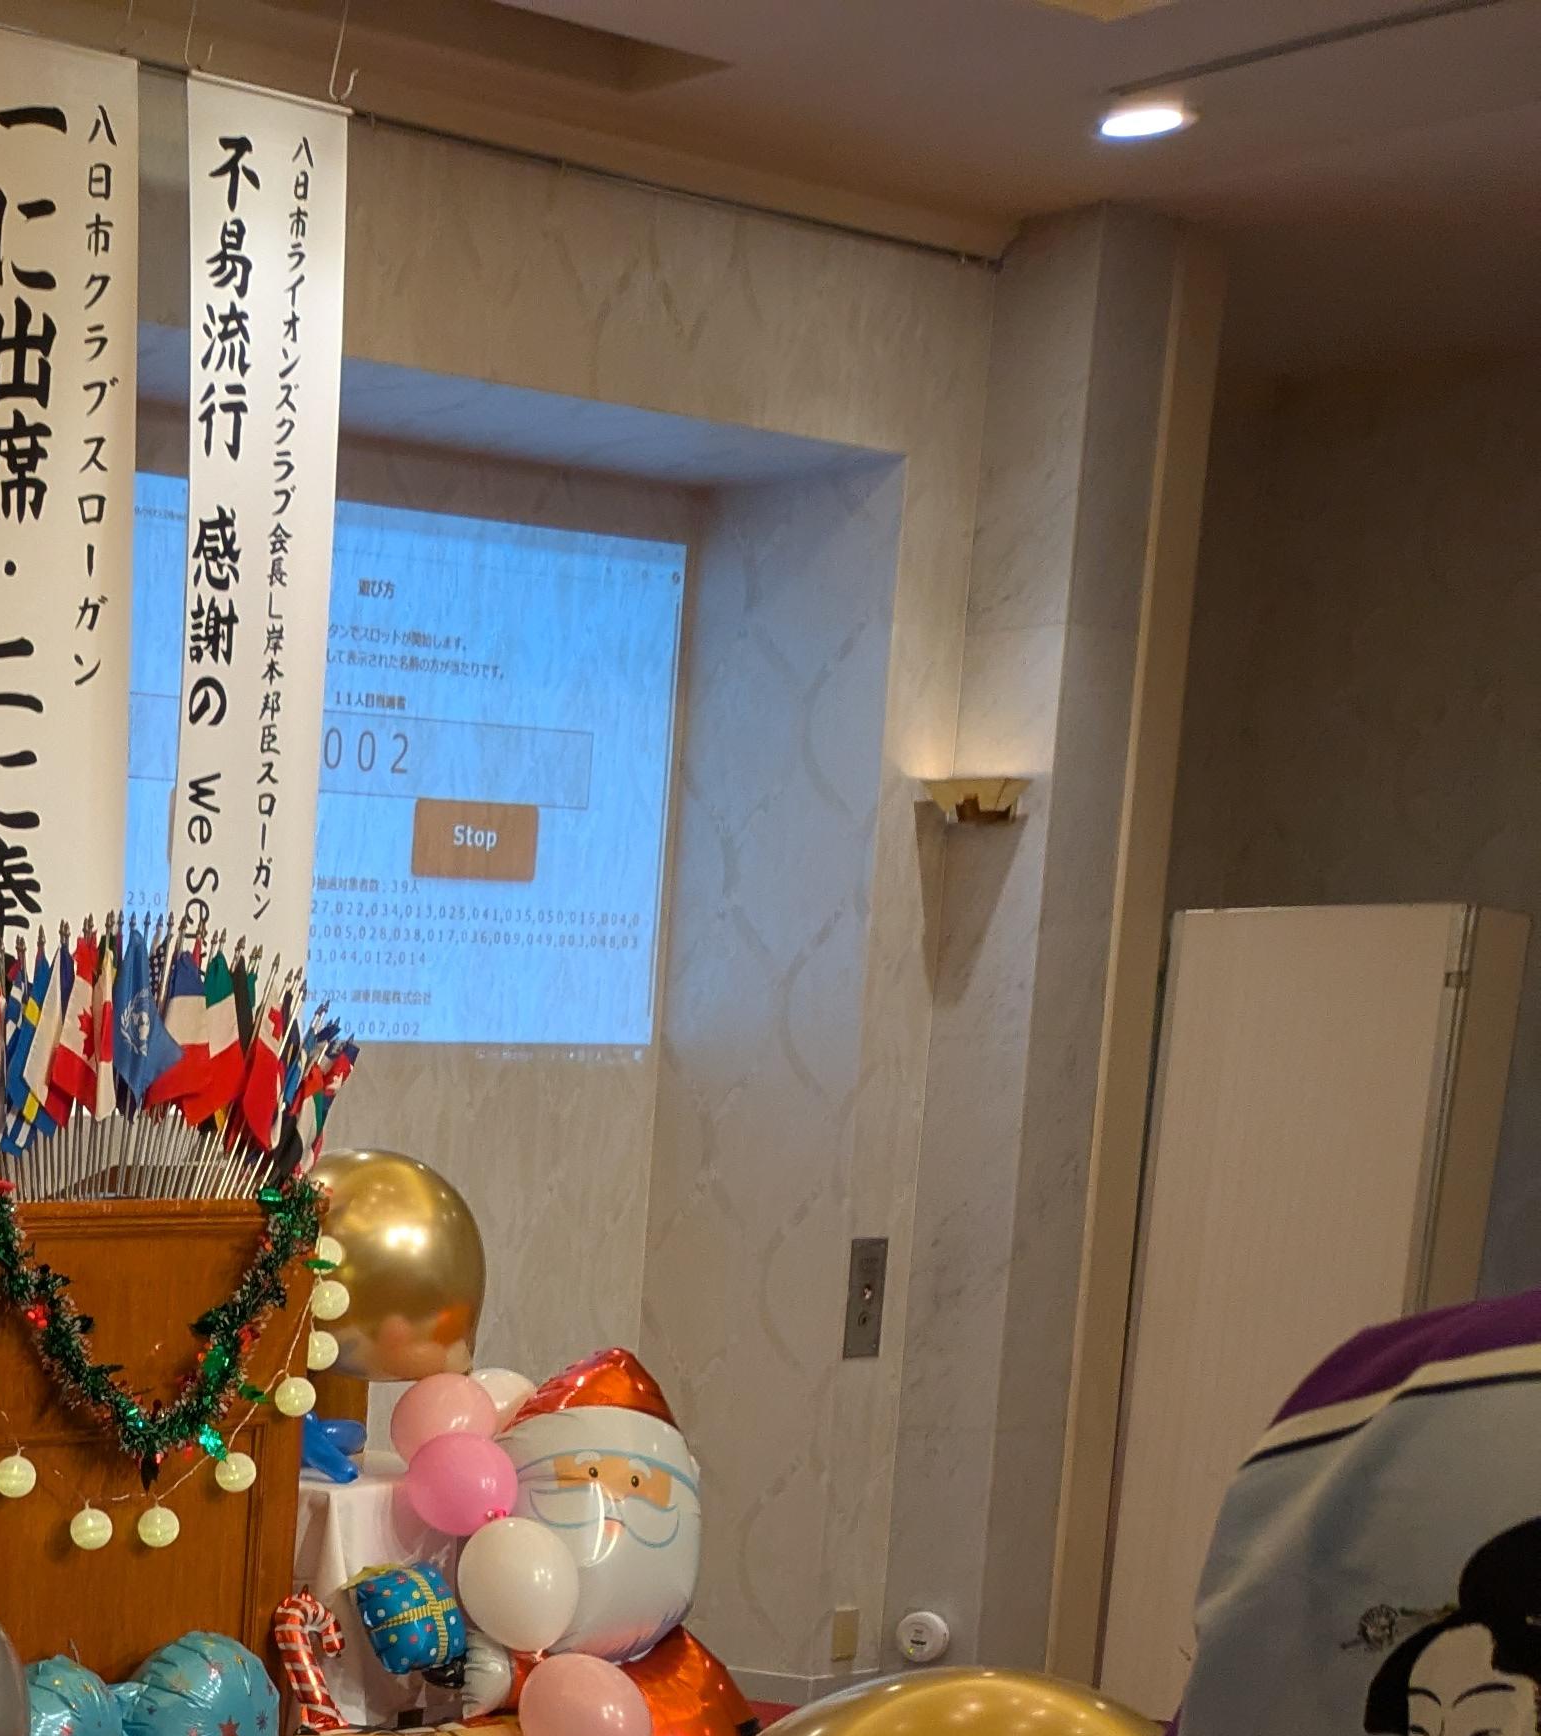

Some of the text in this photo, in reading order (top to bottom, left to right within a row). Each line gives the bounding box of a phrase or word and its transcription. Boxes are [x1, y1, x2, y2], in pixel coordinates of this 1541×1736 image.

[74, 104, 119, 687] 八日市クラブスローガン
[199, 135, 261, 462] 不易流行
[186, 505, 242, 728] 感謝の
[452, 824, 498, 852] Stop
